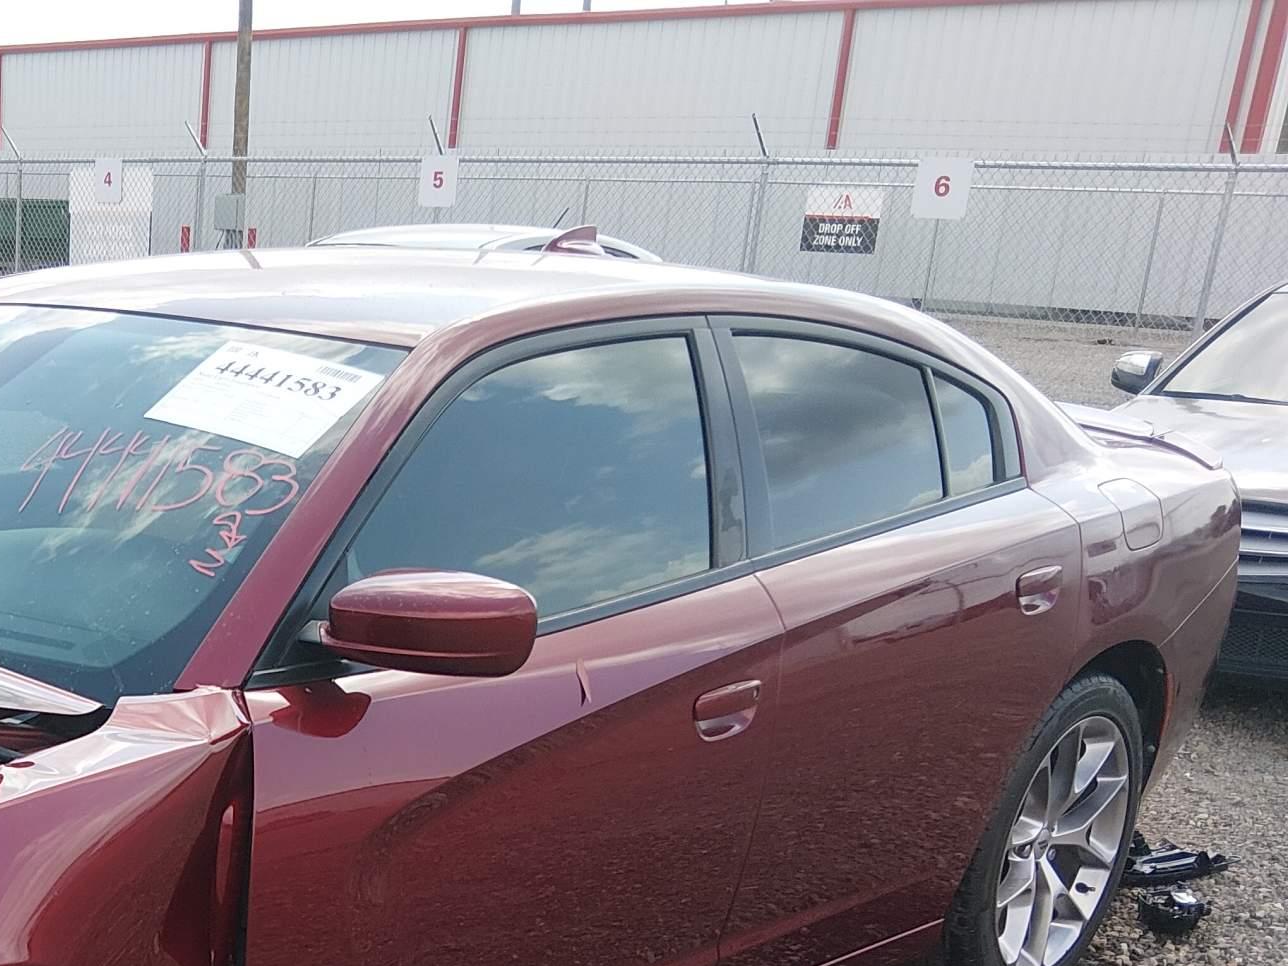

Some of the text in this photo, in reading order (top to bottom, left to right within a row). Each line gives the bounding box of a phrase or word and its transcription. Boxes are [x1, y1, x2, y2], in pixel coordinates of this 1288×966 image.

[103, 171, 113, 187] 4
[433, 171, 444, 189] 5
[934, 175, 951, 197] 6
[818, 223, 862, 235] DROP OFF
[813, 234, 864, 247] ZONE ONLY
[215, 360, 343, 401] 44441583
